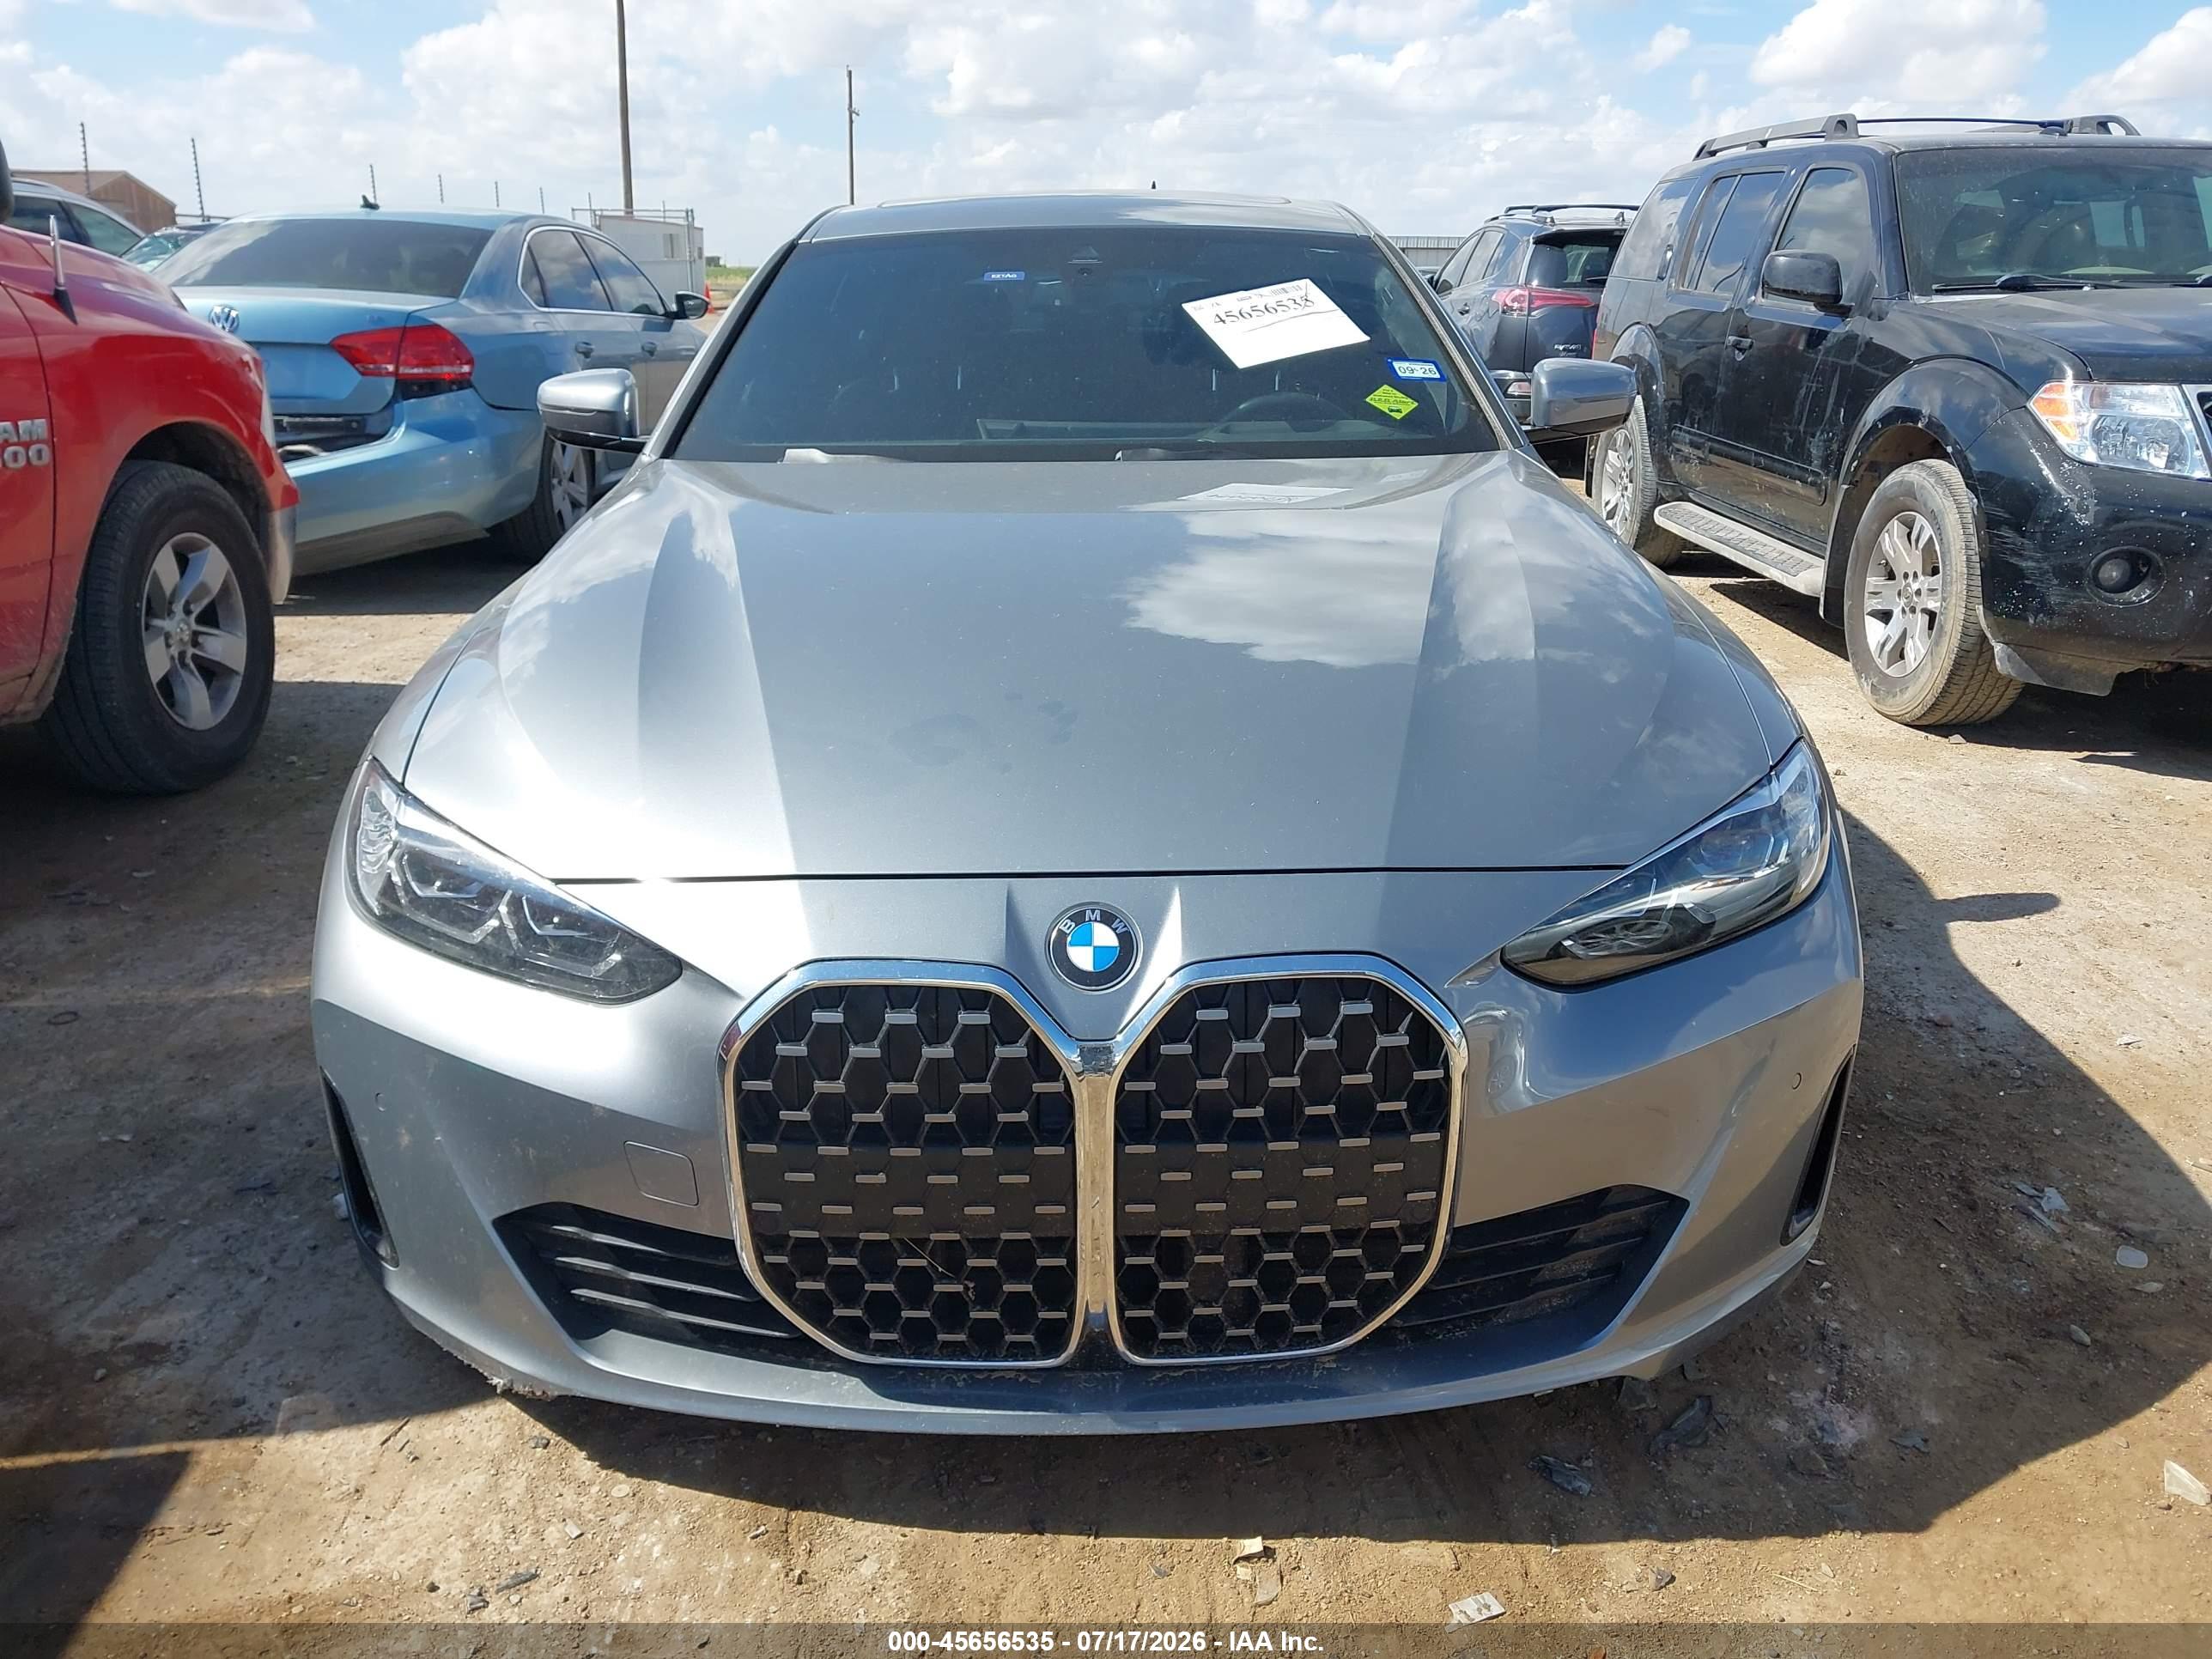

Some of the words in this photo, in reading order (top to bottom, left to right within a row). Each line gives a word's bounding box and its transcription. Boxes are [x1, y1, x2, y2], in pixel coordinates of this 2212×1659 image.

[0, 418, 48, 443] AM
[0, 443, 51, 469] 00
[1059, 908, 1130, 935] BMW
